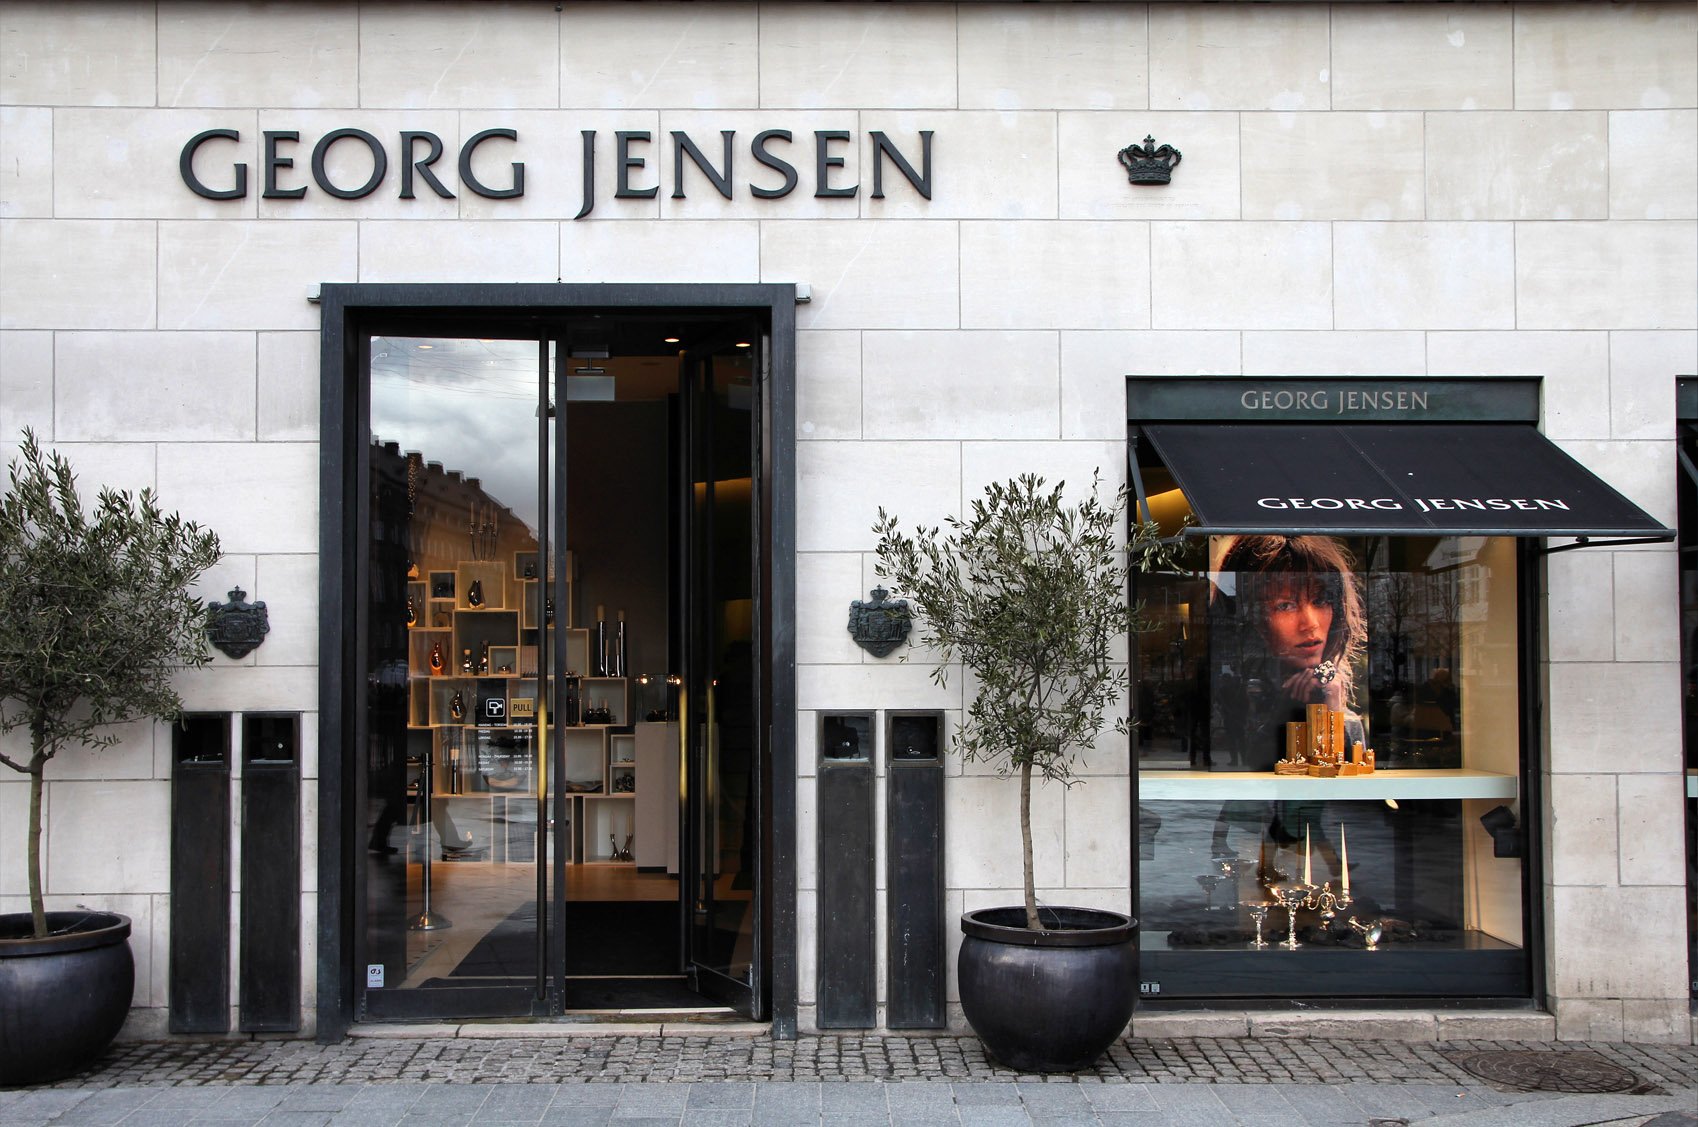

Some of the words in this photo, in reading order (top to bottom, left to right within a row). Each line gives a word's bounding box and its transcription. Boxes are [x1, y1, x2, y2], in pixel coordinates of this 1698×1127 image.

[180, 128, 525, 203] GEORG
[574, 129, 935, 221] JENSEN
[1240, 390, 1328, 410] GEORG
[1336, 390, 1429, 415] JENSEN
[1256, 497, 1403, 510] GEORG
[1415, 498, 1570, 513] JENSEN
[513, 703, 531, 712] PULL
